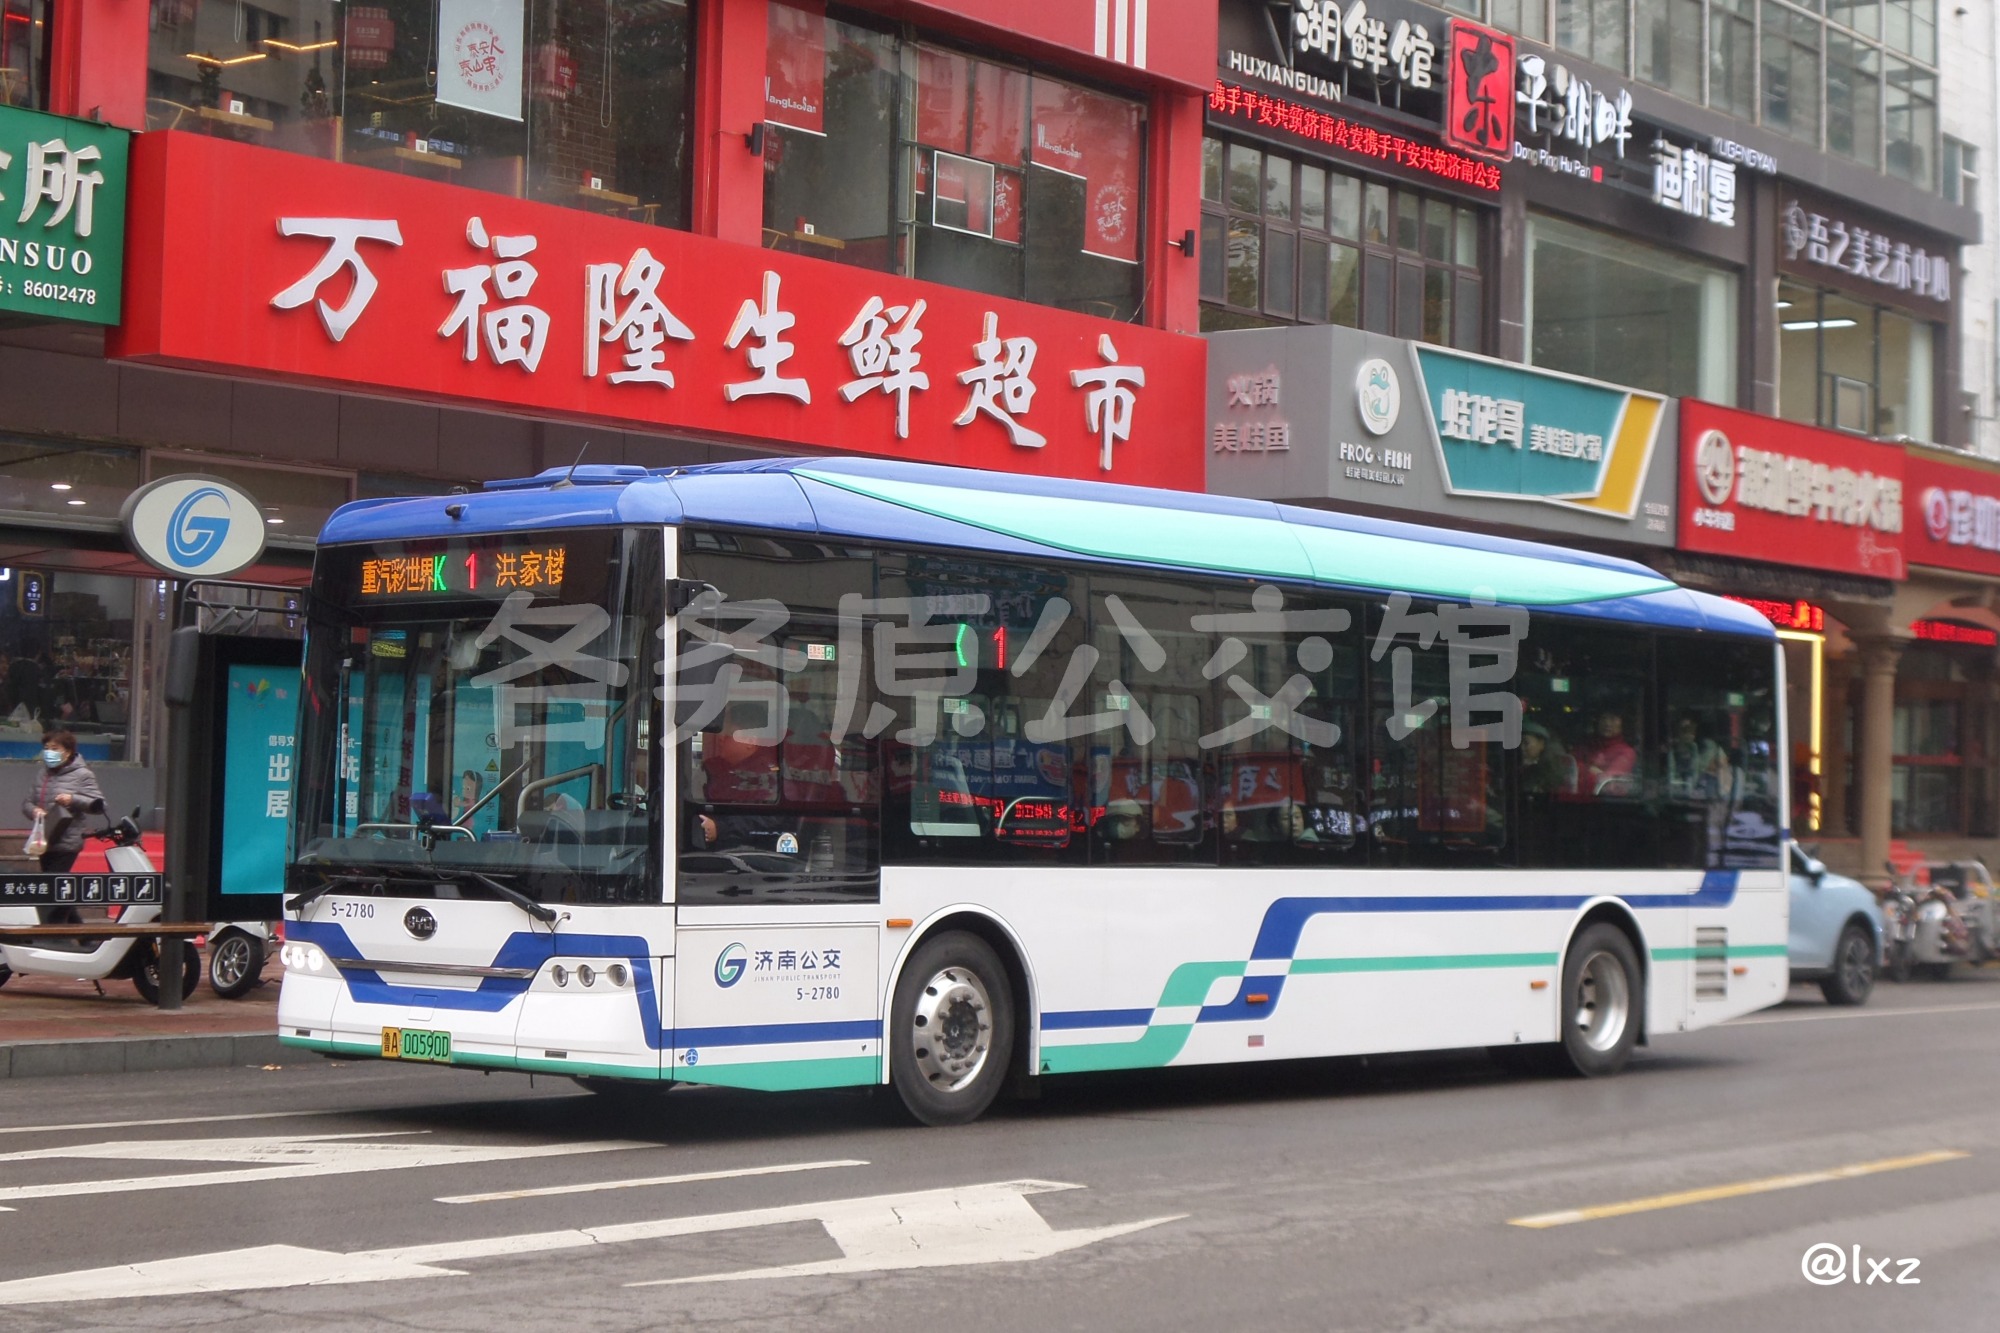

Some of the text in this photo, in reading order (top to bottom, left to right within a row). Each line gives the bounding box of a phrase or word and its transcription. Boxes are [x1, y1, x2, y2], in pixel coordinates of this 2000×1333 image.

[1294, 0, 1435, 88] 湖鲜馆
[1230, 49, 1342, 103] HUXIANGUAN
[1807, 212, 1952, 303] 吾之美艺术中心
[23, 279, 97, 305] 86012478
[270, 215, 1146, 472] 万福隆生鲜超市
[1229, 372, 1281, 407] 火锅
[1213, 423, 1290, 454] 美蛙鱼
[1339, 441, 1412, 470] FROG FISH
[361, 547, 566, 595] 重汽彩世界 K 1 洪家楼
[268, 753, 291, 782] 出
[266, 790, 289, 818] 居
[4, 882, 49, 896] 爱心专座
[331, 902, 375, 919] 5-2780
[754, 949, 841, 972] 济南公交
[776, 974, 801, 982] PUBLIC
[803, 973, 841, 981] TRANSPORT
[796, 986, 840, 1001] 5-2780
